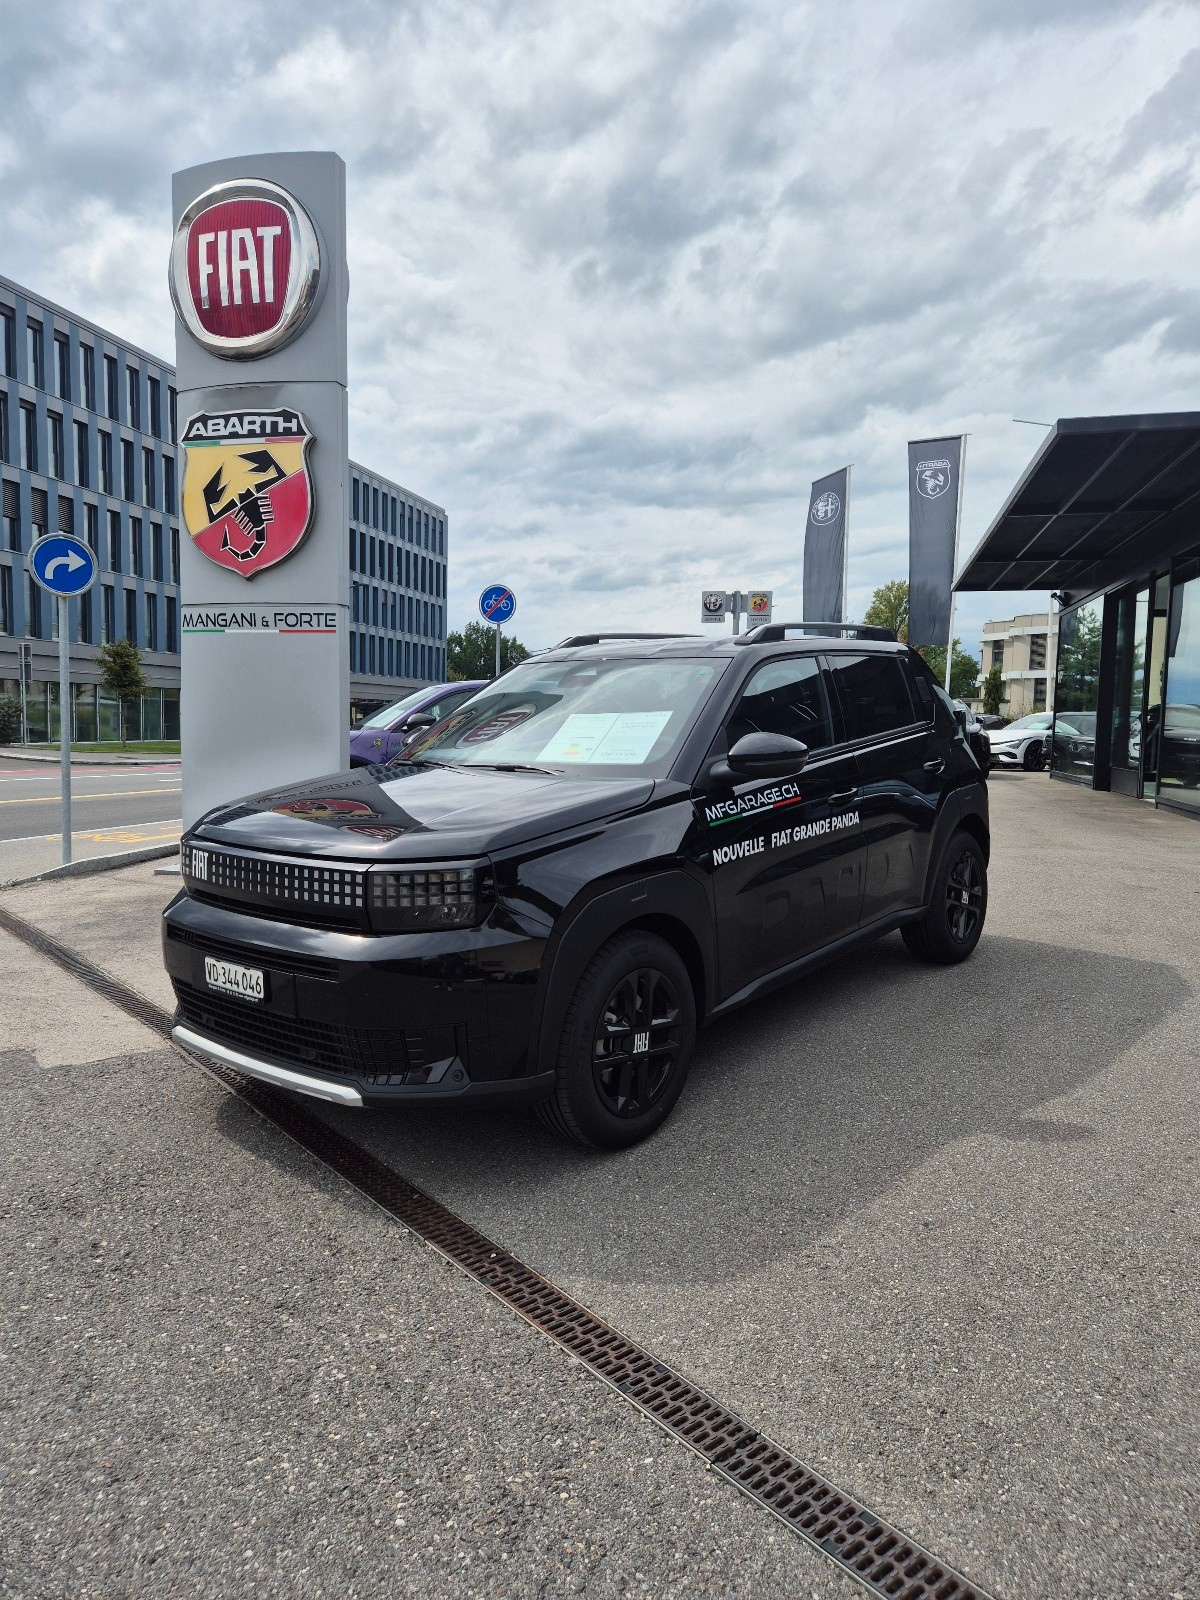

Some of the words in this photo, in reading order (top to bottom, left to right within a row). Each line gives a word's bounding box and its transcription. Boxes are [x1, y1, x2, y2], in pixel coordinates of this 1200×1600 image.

[198, 226, 281, 309] FIAT
[188, 415, 298, 438] ABARTH
[182, 612, 256, 628] MANGANI
[261, 617, 269, 626] &
[273, 612, 337, 628] FORTE
[704, 782, 800, 821] MFGARAGE.CH
[712, 836, 765, 866] NOUVELLE
[771, 829, 792, 848] FIAT
[793, 818, 831, 841] GRANDE
[831, 811, 860, 831] PANDA
[191, 848, 209, 881] FIAT
